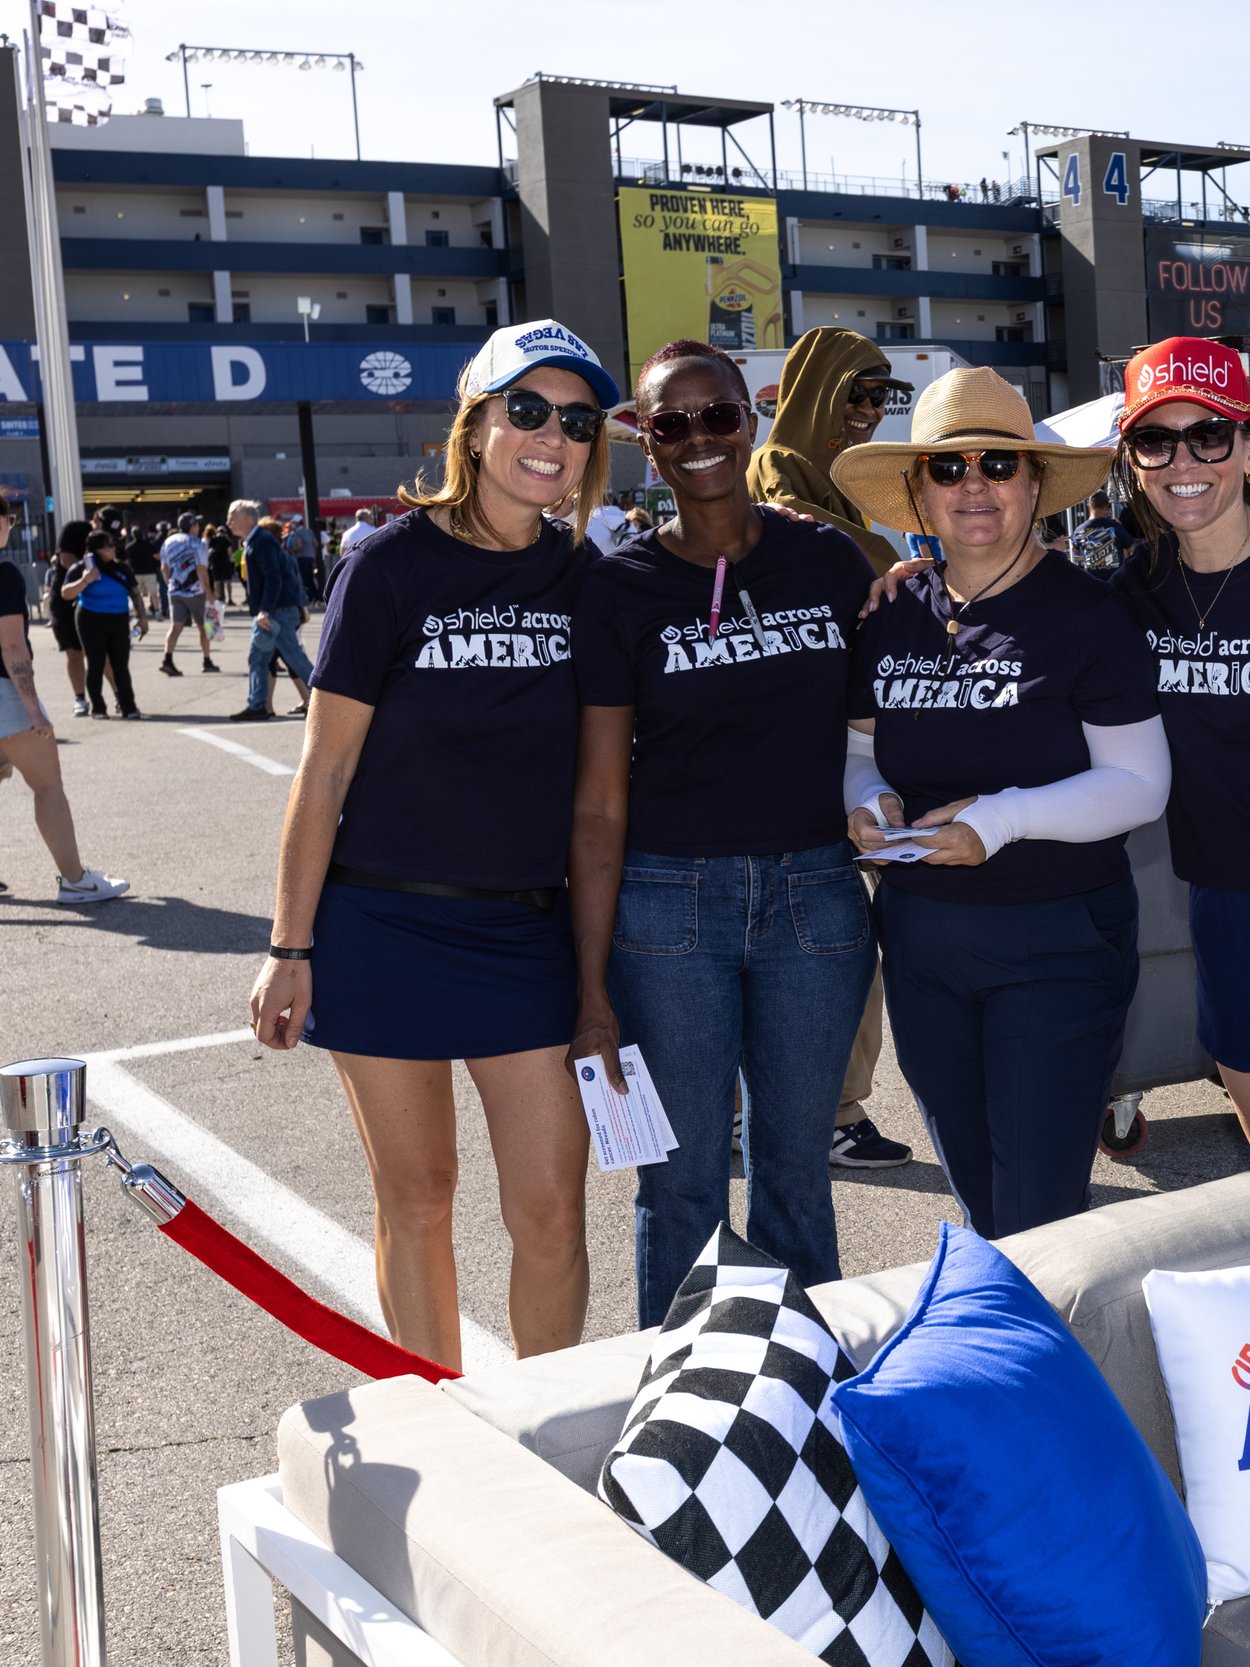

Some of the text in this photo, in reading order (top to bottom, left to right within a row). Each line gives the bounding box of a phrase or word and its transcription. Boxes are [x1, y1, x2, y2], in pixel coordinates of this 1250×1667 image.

[1063, 153, 1081, 206] 4
[1103, 152, 1129, 205] 4
[650, 194, 750, 221] PROVEN HERE,
[633, 214, 760, 239] so you can go
[663, 233, 746, 255] ANYWHERE.
[1158, 261, 1249, 294] FOLLOW
[1190, 300, 1222, 329] US
[515, 327, 565, 349] VEGAS
[523, 345, 550, 354] MOTOR
[211, 345, 267, 401] D
[885, 407, 912, 416] WAY
[521, 612, 572, 630] acros
[762, 605, 832, 626] across
[415, 627, 572, 669] AMERIC
[956, 659, 1023, 677] across
